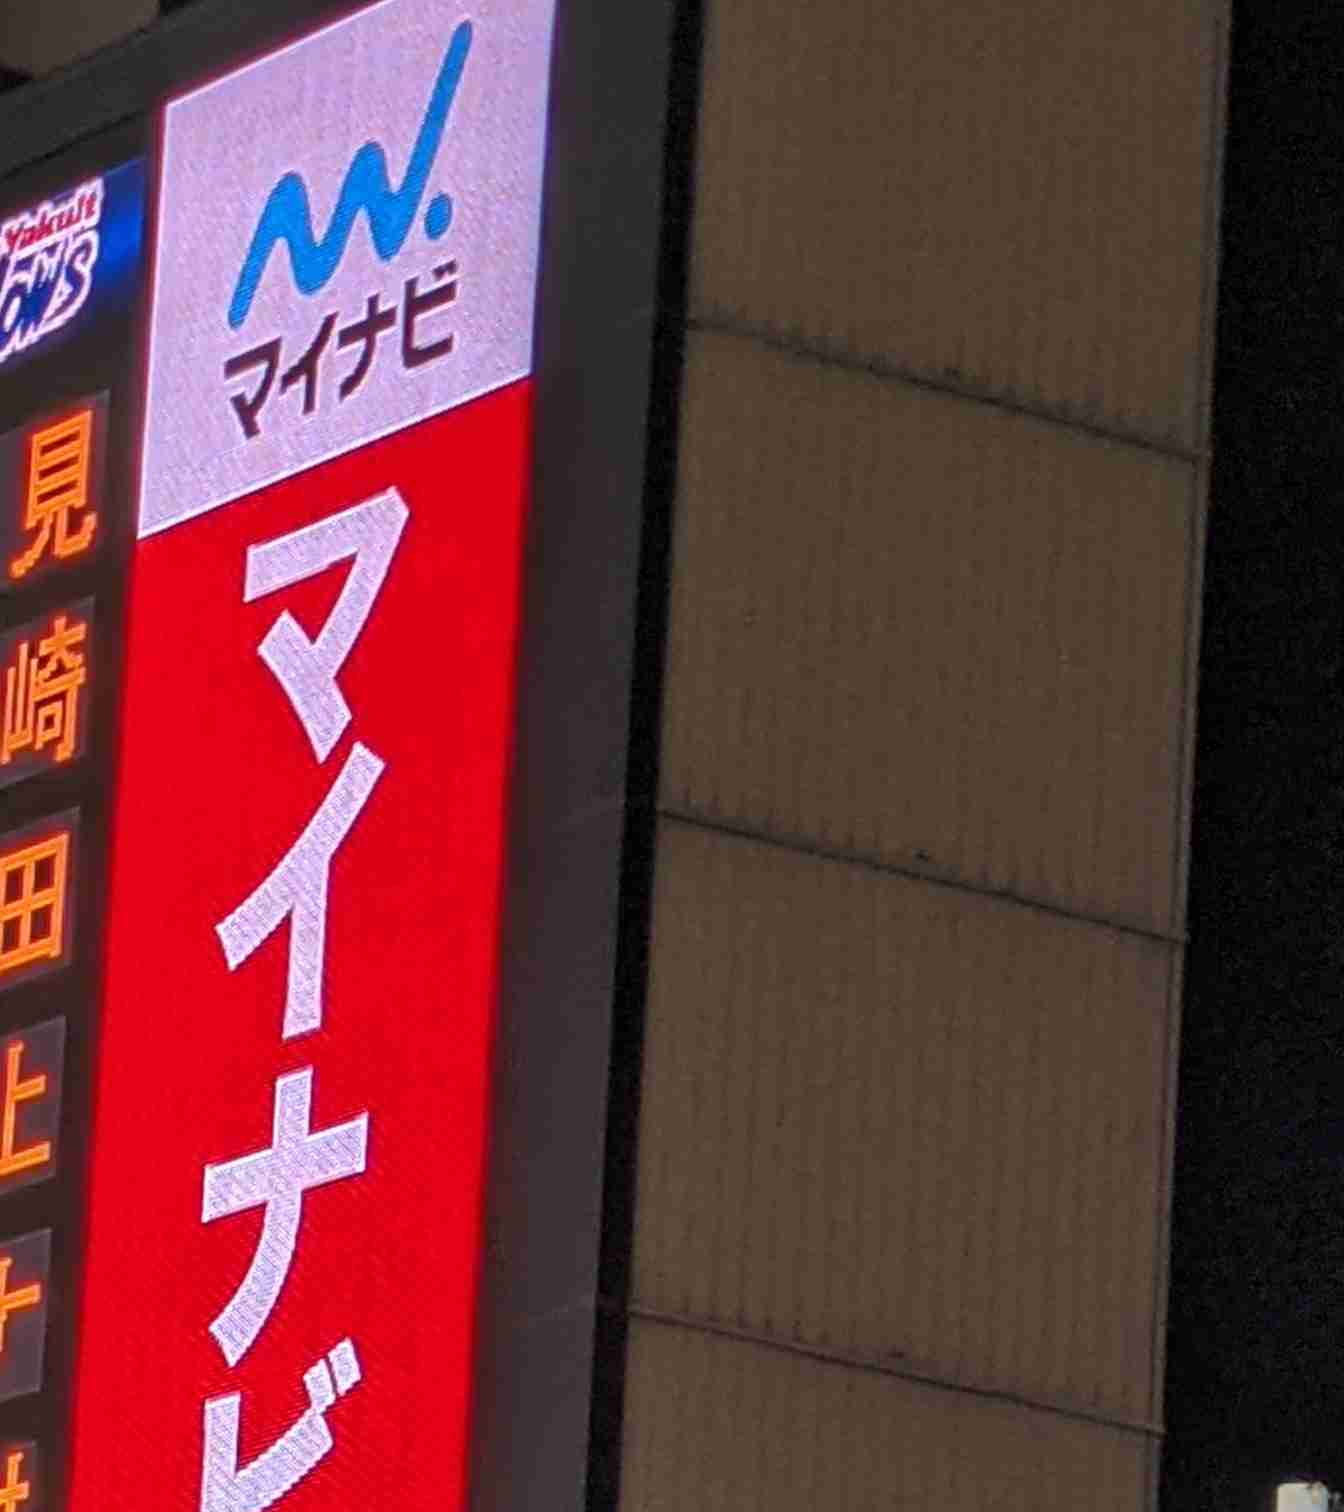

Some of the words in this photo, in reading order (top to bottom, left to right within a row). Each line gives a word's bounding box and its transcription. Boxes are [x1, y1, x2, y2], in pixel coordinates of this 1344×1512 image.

[4, 182, 100, 250] Yakult
[223, 260, 458, 440] マイナビ
